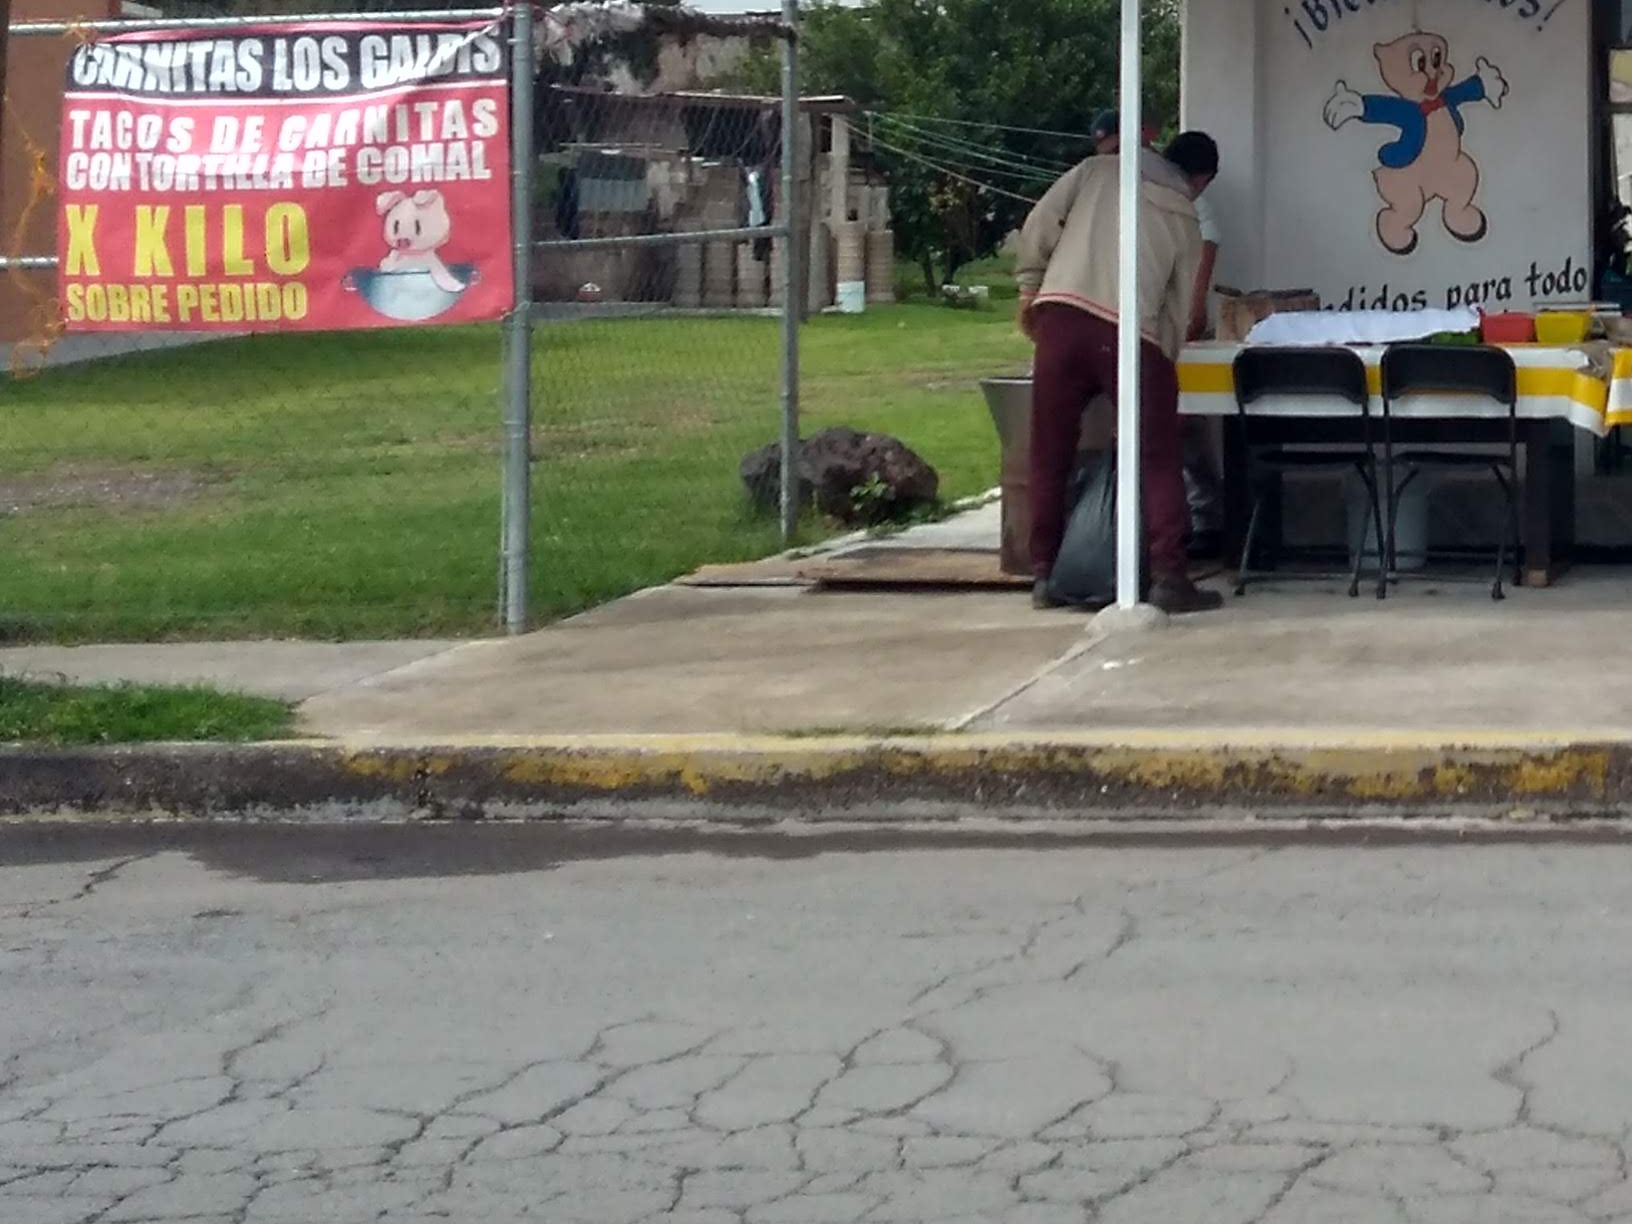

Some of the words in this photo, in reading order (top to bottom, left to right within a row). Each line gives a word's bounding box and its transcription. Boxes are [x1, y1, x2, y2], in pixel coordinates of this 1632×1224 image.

[74, 38, 264, 93] CARNITAS
[272, 36, 350, 91] LOS
[69, 110, 195, 153] TACOS
[210, 115, 265, 154] DE
[280, 98, 498, 152] CARNITAS
[67, 151, 132, 191] CON
[135, 152, 294, 191] TORTILLA
[302, 147, 348, 188] DE
[356, 140, 492, 185] COMAL
[65, 203, 101, 276] X
[133, 201, 310, 276] KILO
[67, 283, 171, 323] SOBRE
[177, 282, 308, 322] PEDIDO
[1447, 275, 1512, 311] para
[1525, 257, 1588, 297] todo
